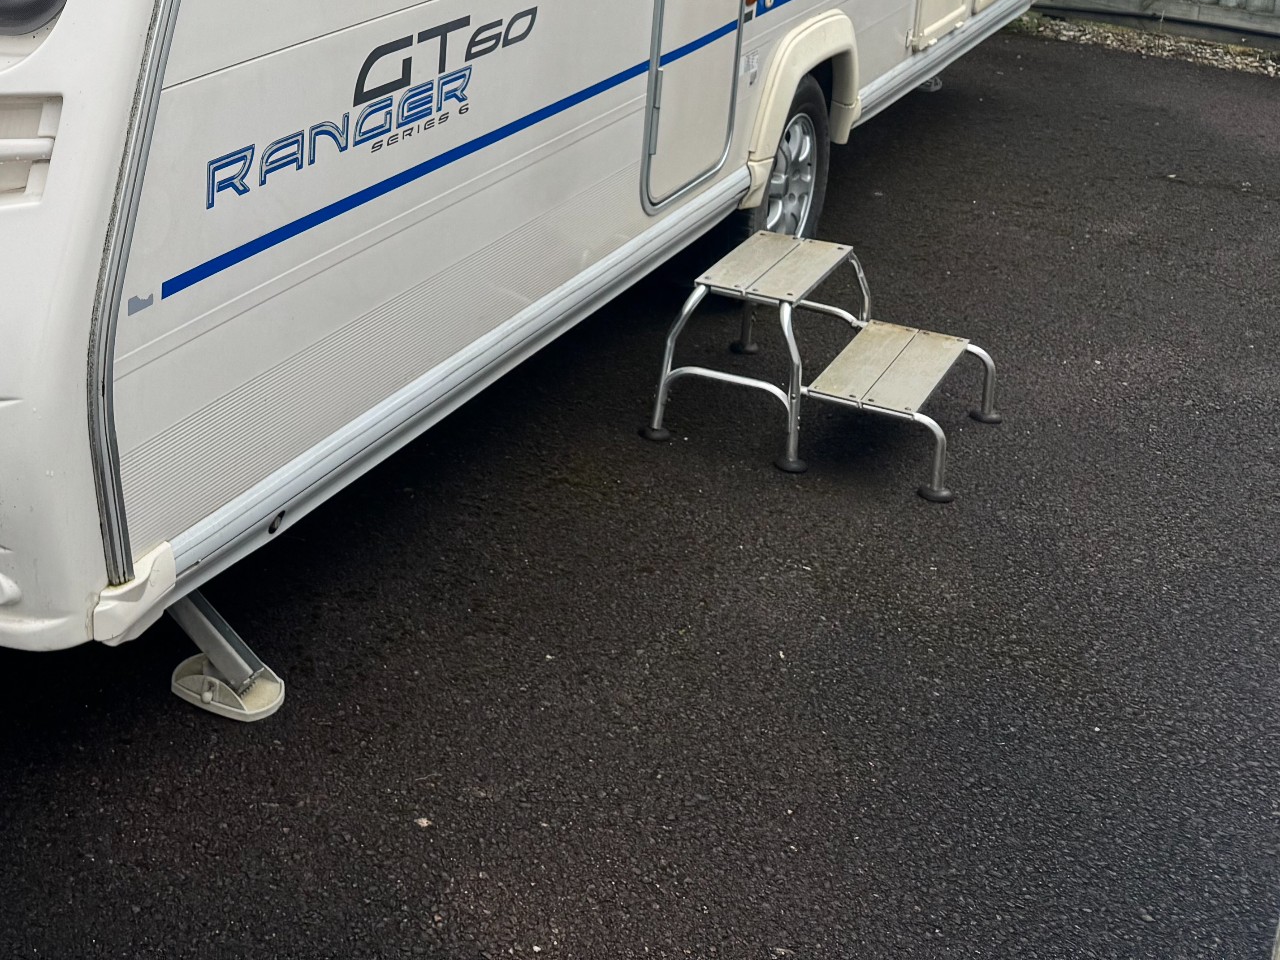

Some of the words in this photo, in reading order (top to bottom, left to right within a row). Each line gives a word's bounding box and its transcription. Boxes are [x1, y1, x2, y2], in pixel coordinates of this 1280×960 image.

[206, 64, 472, 209] RANGER
[370, 111, 449, 153] SERIES
[458, 103, 470, 115] 6
